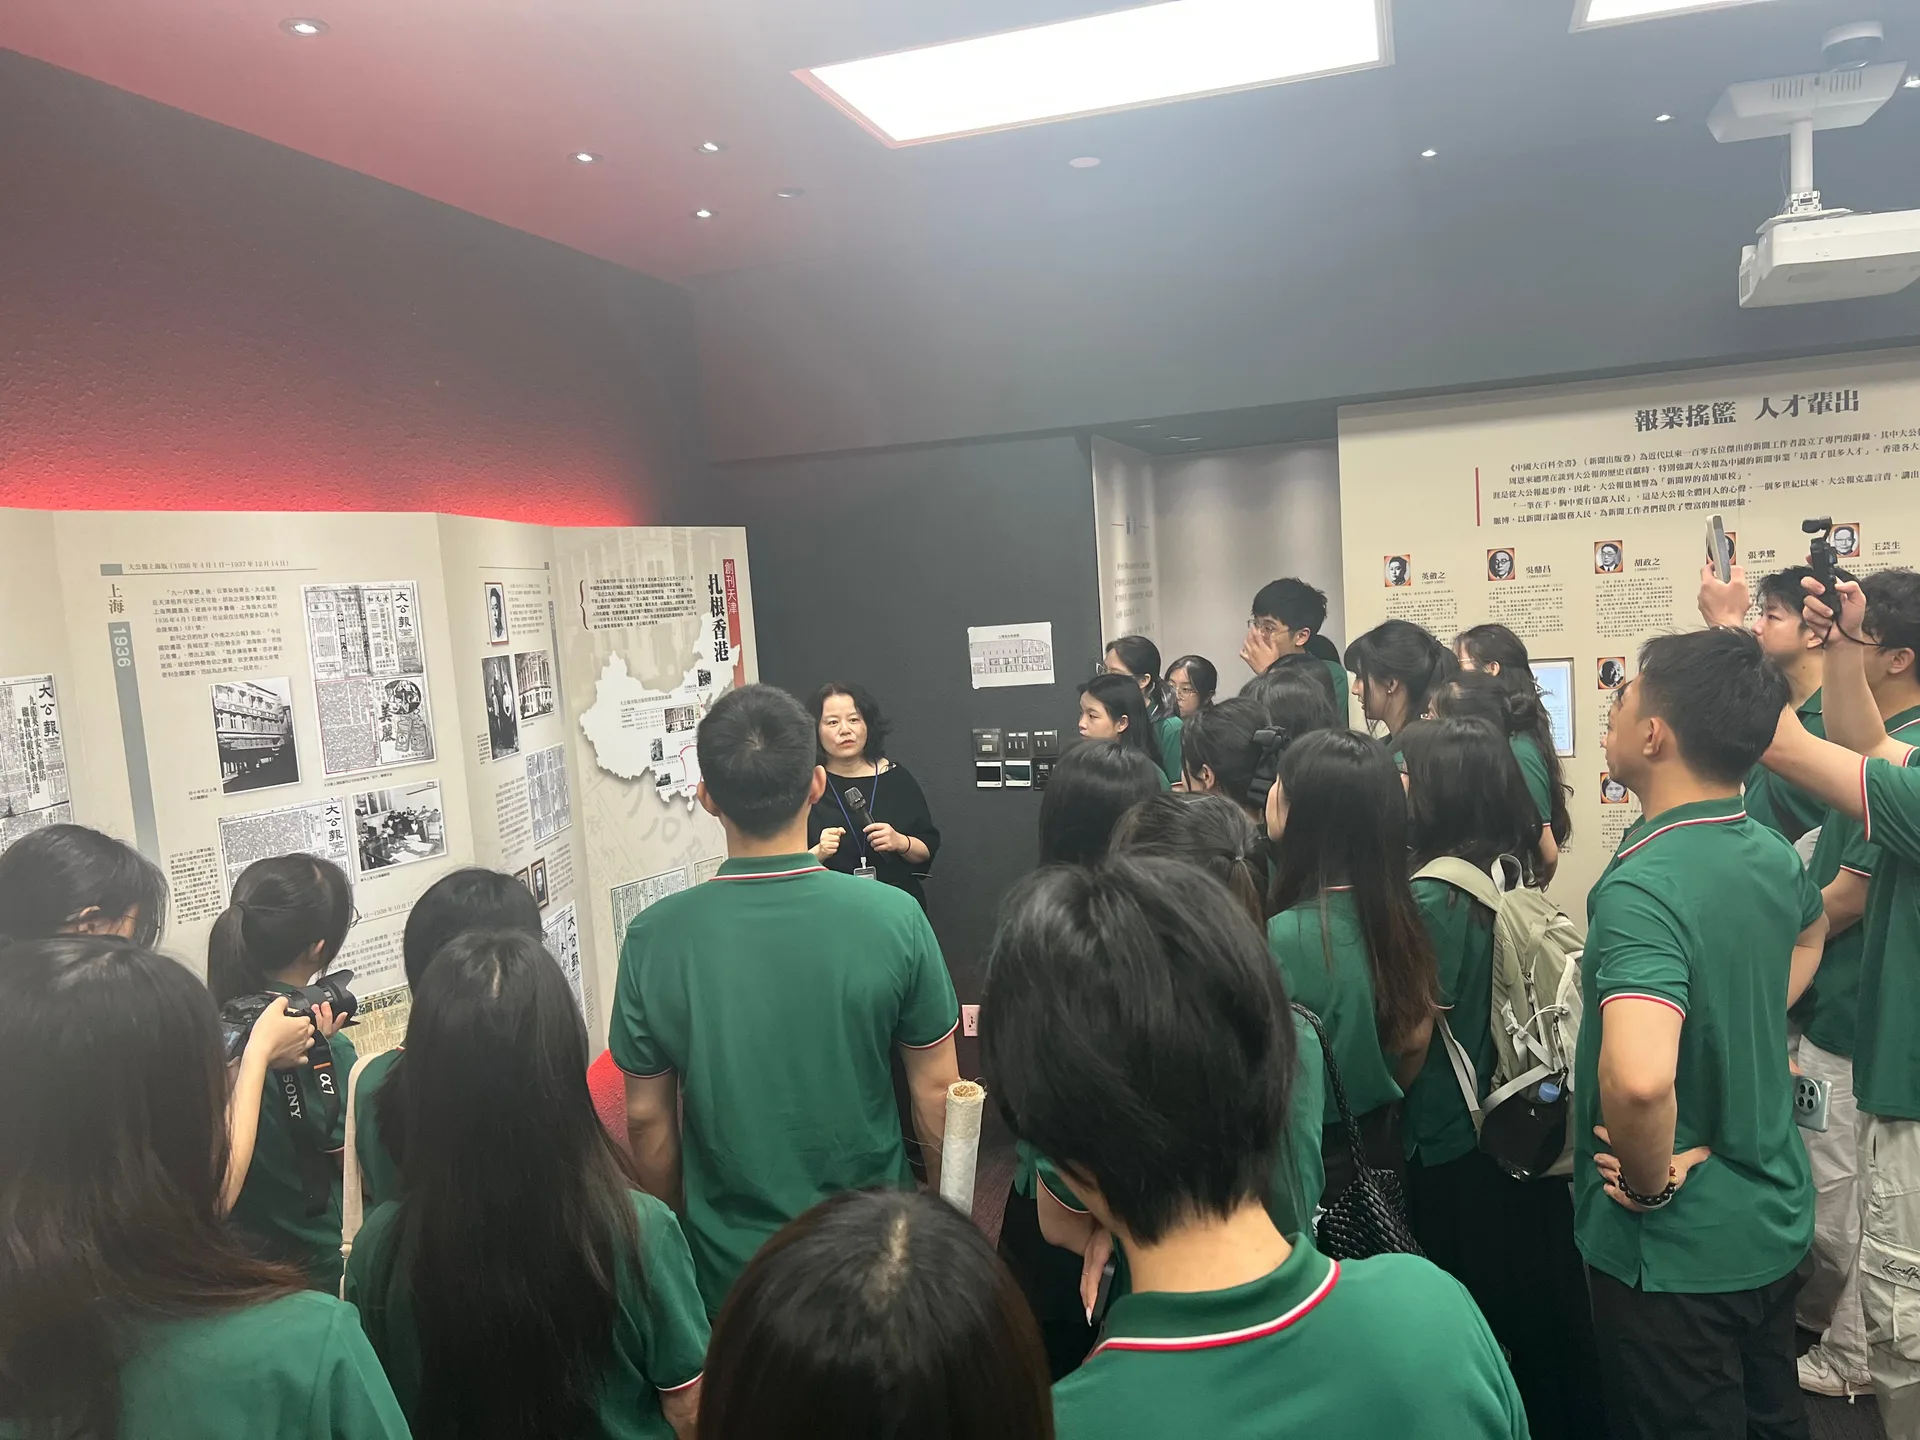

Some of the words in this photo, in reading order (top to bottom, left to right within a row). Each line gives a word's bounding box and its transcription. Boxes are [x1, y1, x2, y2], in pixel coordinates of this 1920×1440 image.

[1634, 400, 1736, 432] 報業搖籃
[1755, 389, 1859, 421] 人才輩出
[1634, 558, 1661, 567] 胡政之
[1872, 541, 1900, 551] 王芸生
[108, 583, 125, 614] 上海
[724, 561, 738, 614] 創刊天津
[395, 591, 412, 628] 大公報
[708, 573, 729, 662] 扎根香港
[112, 627, 131, 668] 1936
[38, 684, 59, 737] 大公報
[325, 804, 344, 841] 大公報
[282, 1074, 301, 1119] SONY
